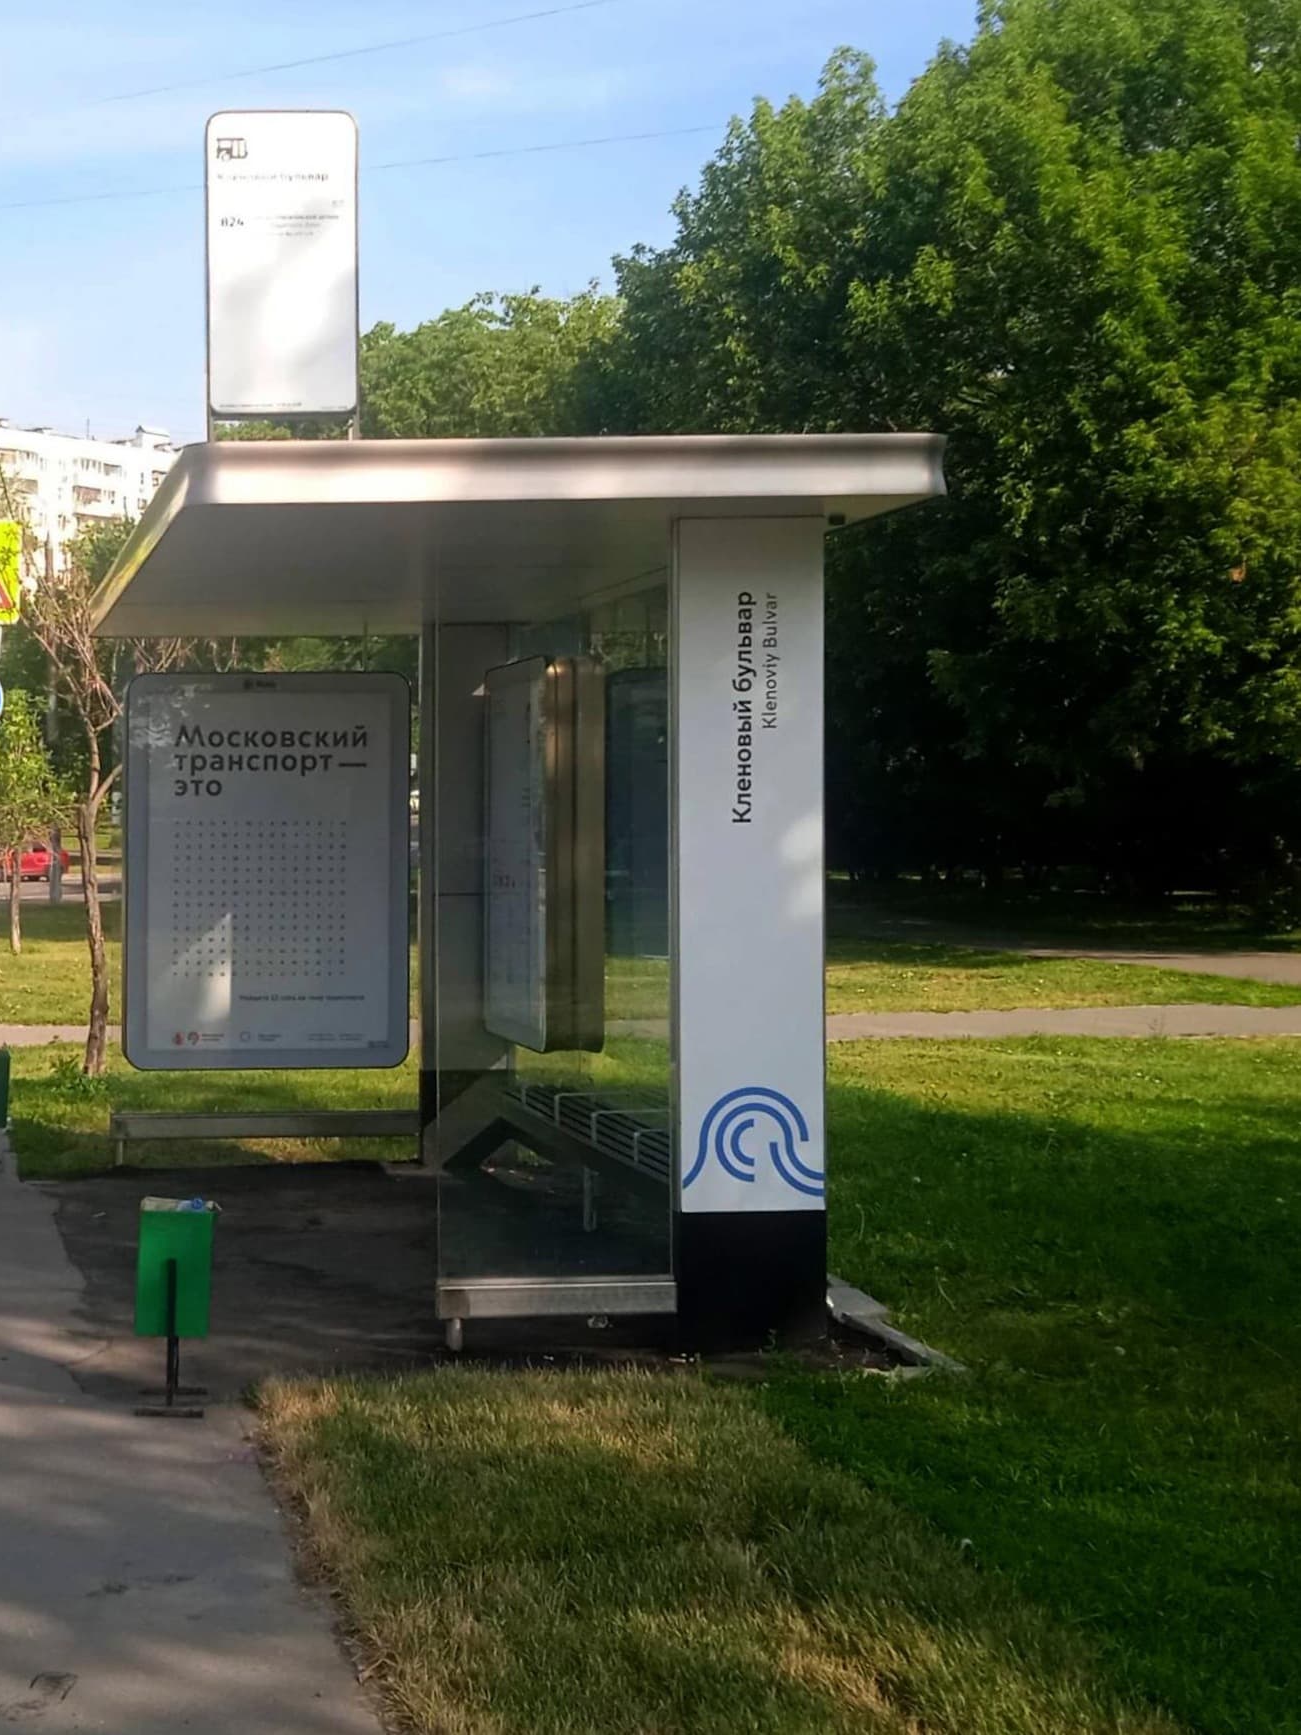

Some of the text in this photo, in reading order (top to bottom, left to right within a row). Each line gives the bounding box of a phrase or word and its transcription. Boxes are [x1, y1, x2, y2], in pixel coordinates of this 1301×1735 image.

[762, 592, 781, 729] Klenoviy Bulvar
[174, 725, 368, 748] Московский
[732, 591, 757, 823] Кленовый бульвар
[174, 779, 223, 797] это
